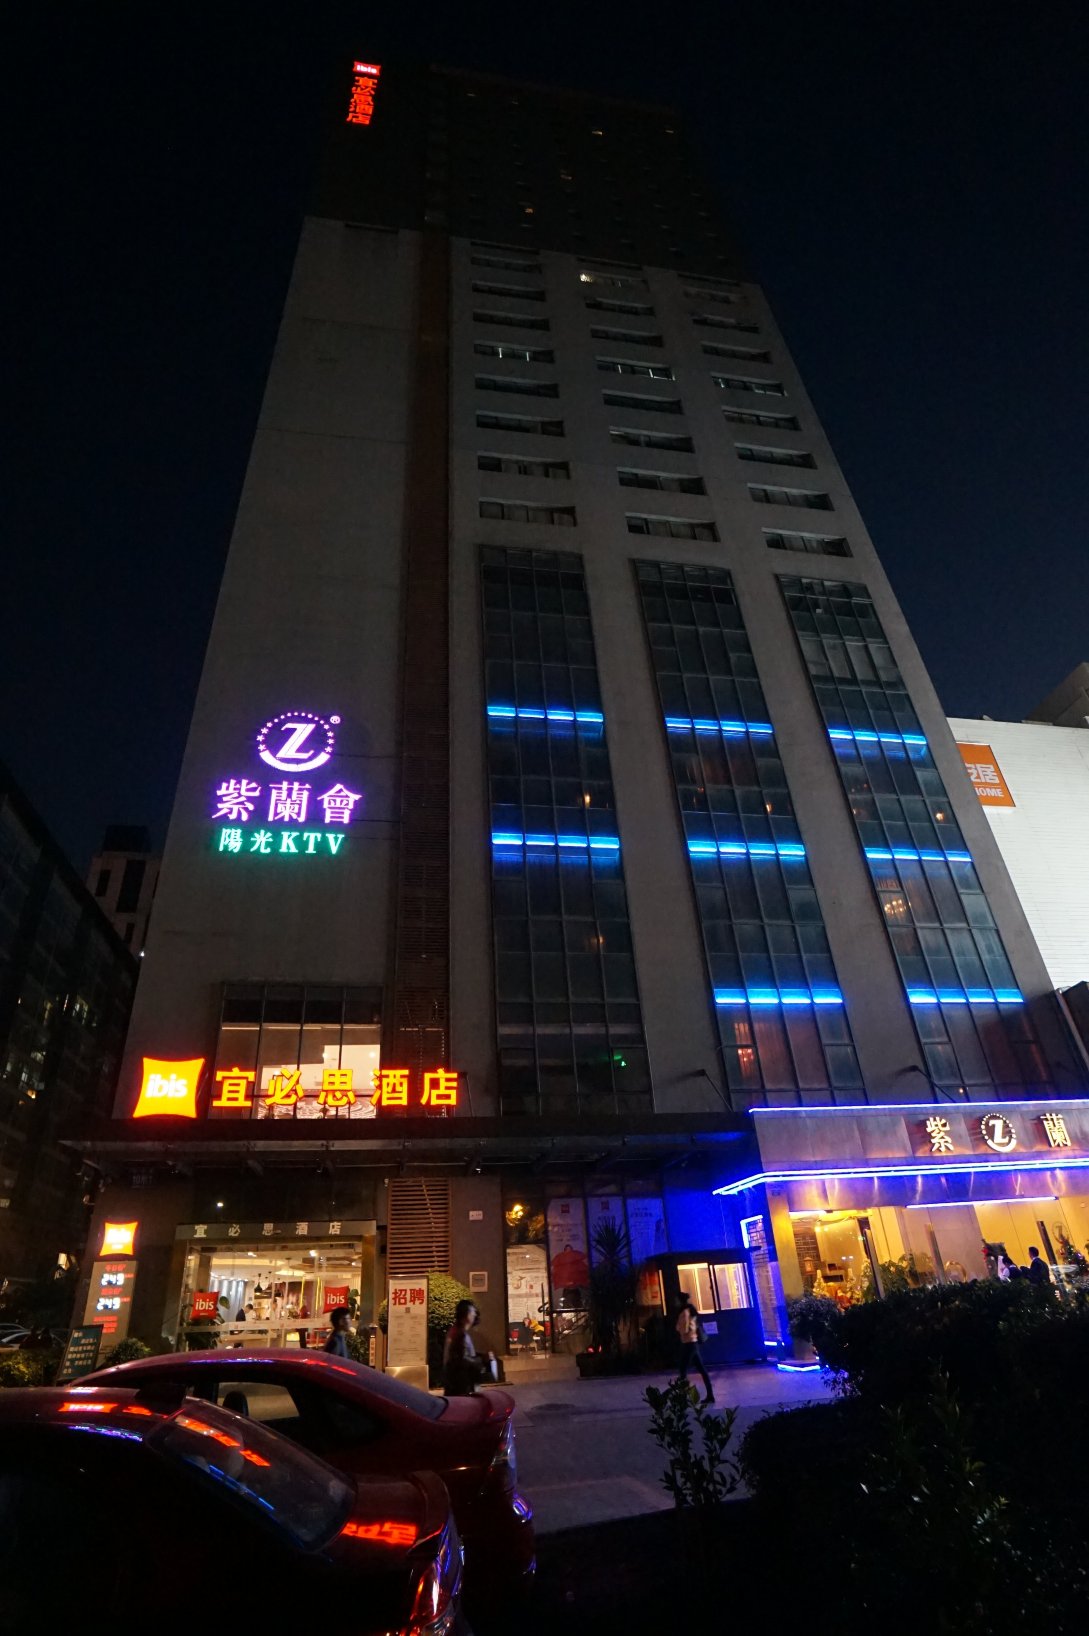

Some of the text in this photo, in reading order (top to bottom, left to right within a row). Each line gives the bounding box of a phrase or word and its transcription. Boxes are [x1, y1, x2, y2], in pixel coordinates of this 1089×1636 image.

[211, 779, 363, 824] 紫蘭會
[145, 1073, 188, 1099] ibis
[211, 1067, 458, 1107] 宜必思酒店
[193, 1221, 342, 1238] 宜必思酒店
[195, 1299, 214, 1311] ibis
[327, 1293, 345, 1305] ibis
[391, 1287, 425, 1306] 招聘
